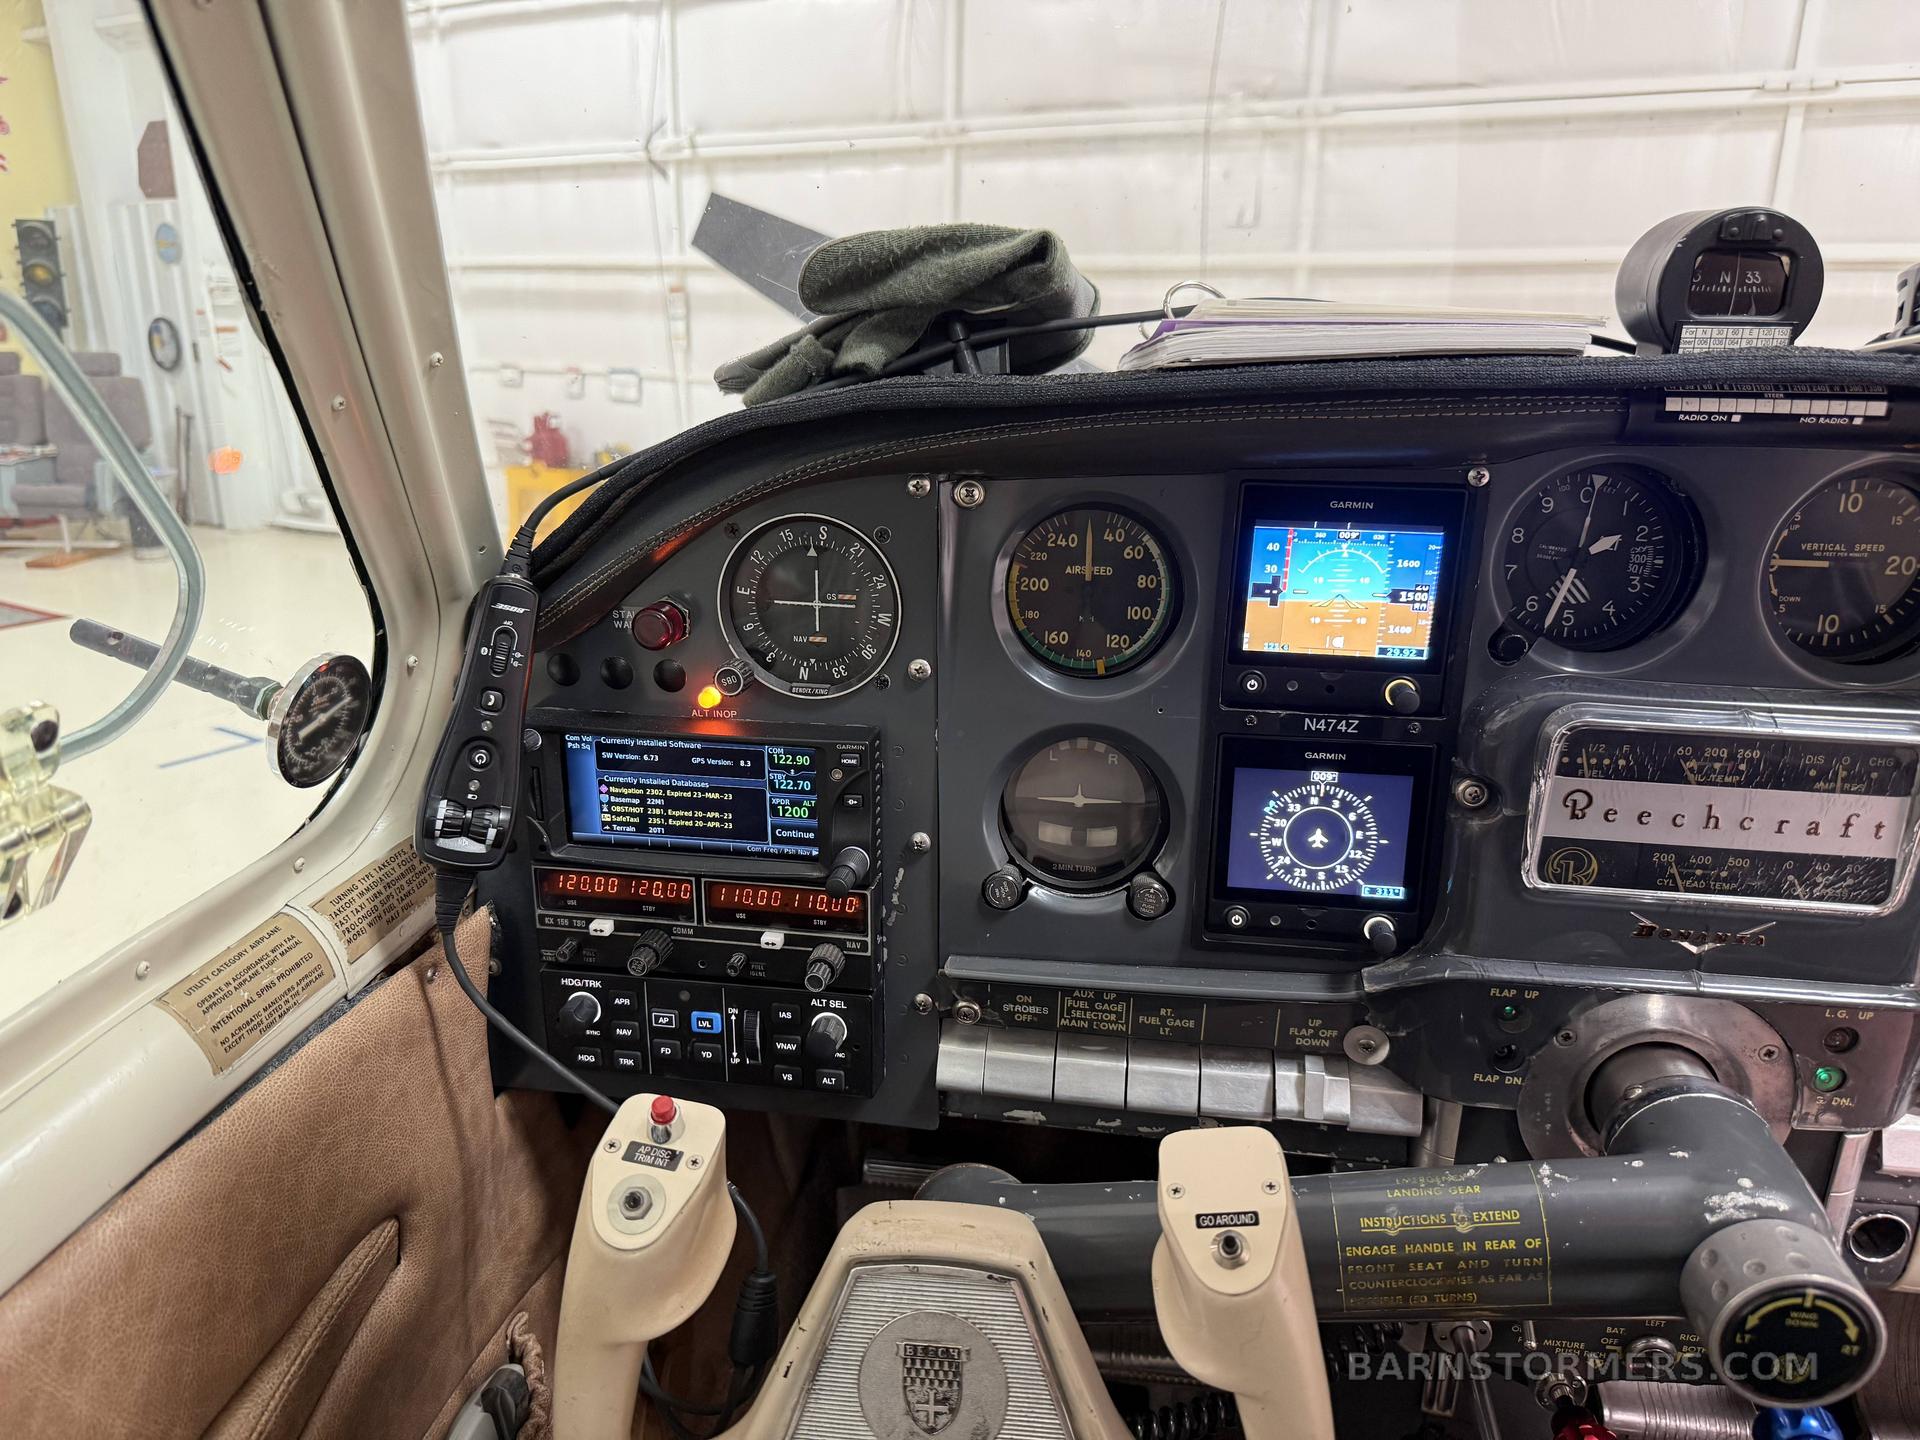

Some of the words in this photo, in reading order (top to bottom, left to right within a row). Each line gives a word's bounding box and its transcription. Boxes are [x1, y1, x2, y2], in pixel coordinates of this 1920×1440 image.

[1720, 272, 1731, 284] N
[1746, 271, 1761, 284] 33
[1330, 501, 1374, 509] GARMIN
[1839, 493, 1862, 513] 10
[1047, 533, 1078, 547] 240
[1104, 529, 1125, 542] 40
[1124, 546, 1143, 559] 60
[1267, 543, 1279, 551] 40
[1855, 544, 1885, 552] SPEED
[1031, 552, 1047, 560] 220
[1265, 565, 1277, 573] 30
[1884, 556, 1916, 575] 20
[1021, 578, 1049, 591] 200
[1138, 576, 1156, 588] 80
[1025, 611, 1039, 619] 180
[1128, 607, 1151, 620] 100
[1817, 615, 1839, 633] 10
[1045, 632, 1068, 644] 160
[1107, 635, 1129, 647] 120
[1386, 649, 1416, 657] 29.92
[721, 676, 737, 687] OBS
[713, 710, 737, 718] INOP
[1304, 718, 1360, 733] N474Z
[601, 737, 635, 747] Currently
[637, 739, 667, 747] Installed
[669, 741, 701, 749] Software
[773, 754, 810, 765] 122.90
[1305, 752, 1346, 760] GARMIN
[604, 775, 637, 785] Currently
[639, 778, 669, 786] Installed
[672, 780, 709, 788] Databases
[774, 780, 811, 790] 122.70
[610, 787, 643, 795] Navigation
[667, 790, 691, 798] Expired
[693, 792, 732, 800] 23-MAR-23
[610, 796, 640, 805] Basemap
[778, 806, 808, 818] 1200
[1562, 788, 1886, 840] Beechcraft
[776, 829, 814, 838] Continue
[330, 884, 359, 907] TURNING
[358, 872, 374, 886] TYPE
[559, 875, 618, 893] 120.00
[632, 881, 691, 898] 120.00
[721, 888, 781, 905] 110.00
[329, 897, 356, 920] TAKEOFF
[673, 927, 693, 935] COMM
[847, 941, 861, 949] NAV
[184, 976, 211, 996] UTILITY
[211, 949, 249, 977] CATEGORY
[249, 925, 282, 950] AIRPLANE
[197, 984, 224, 1008] OPERATE
[224, 980, 232, 988] IN
[232, 952, 271, 982] ACCORDANCE
[271, 942, 284, 954] WITH
[283, 934, 296, 945] FAA
[201, 990, 233, 1016] APPROVED
[234, 970, 261, 991] AIRPLANE
[261, 955, 279, 971] FLIGHT
[279, 939, 302, 957] MANUAL
[561, 978, 601, 988] HDG/TRK
[210, 997, 256, 1033] INTENTIONAL
[256, 980, 276, 998] SPINS
[277, 952, 314, 982] PROHIBITED
[1073, 990, 1095, 998] AUX
[1104, 992, 1116, 1000] UP
[1490, 988, 1517, 998] FLAP
[1525, 990, 1539, 999] UP
[811, 999, 827, 1007] ALT
[1016, 995, 1031, 1003] ON
[1003, 1004, 1048, 1014] STROBES
[1068, 1000, 1089, 1008] FUEL
[1095, 1003, 1123, 1012] GAGE
[1160, 1008, 1174, 1016] RT.
[1015, 1014, 1032, 1022] OFF
[1071, 1010, 1116, 1020] SELECTOR
[698, 1020, 711, 1028] LVL
[1060, 1019, 1089, 1028] MAIN
[1139, 1016, 1161, 1025] FUEL
[1167, 1019, 1195, 1028] GAGE
[1308, 1019, 1322, 1027] UP
[1160, 1027, 1172, 1035] LT.
[1290, 1028, 1314, 1037] FLAP
[1319, 1029, 1338, 1037] OFF
[1295, 1038, 1329, 1047] DOWN
[1473, 1073, 1499, 1083] FLAP
[638, 1145, 650, 1153] AP
[651, 1148, 672, 1158] DISC
[634, 1153, 654, 1164] TRIM
[654, 1157, 670, 1166] INT
[1387, 1188, 1442, 1198] LANDING
[1449, 1185, 1481, 1194] GEAR
[1200, 1215, 1214, 1226] GO
[1216, 1214, 1256, 1225] AROUND
[1360, 1214, 1446, 1228] INSTRUCTIONS
[1473, 1210, 1520, 1222] EXTEND
[1346, 1245, 1397, 1257] ENGAGE
[1405, 1242, 1454, 1254] HANDLE
[1463, 1241, 1476, 1251] IN
[1485, 1240, 1516, 1250] REAR
[1525, 1239, 1542, 1248] OF
